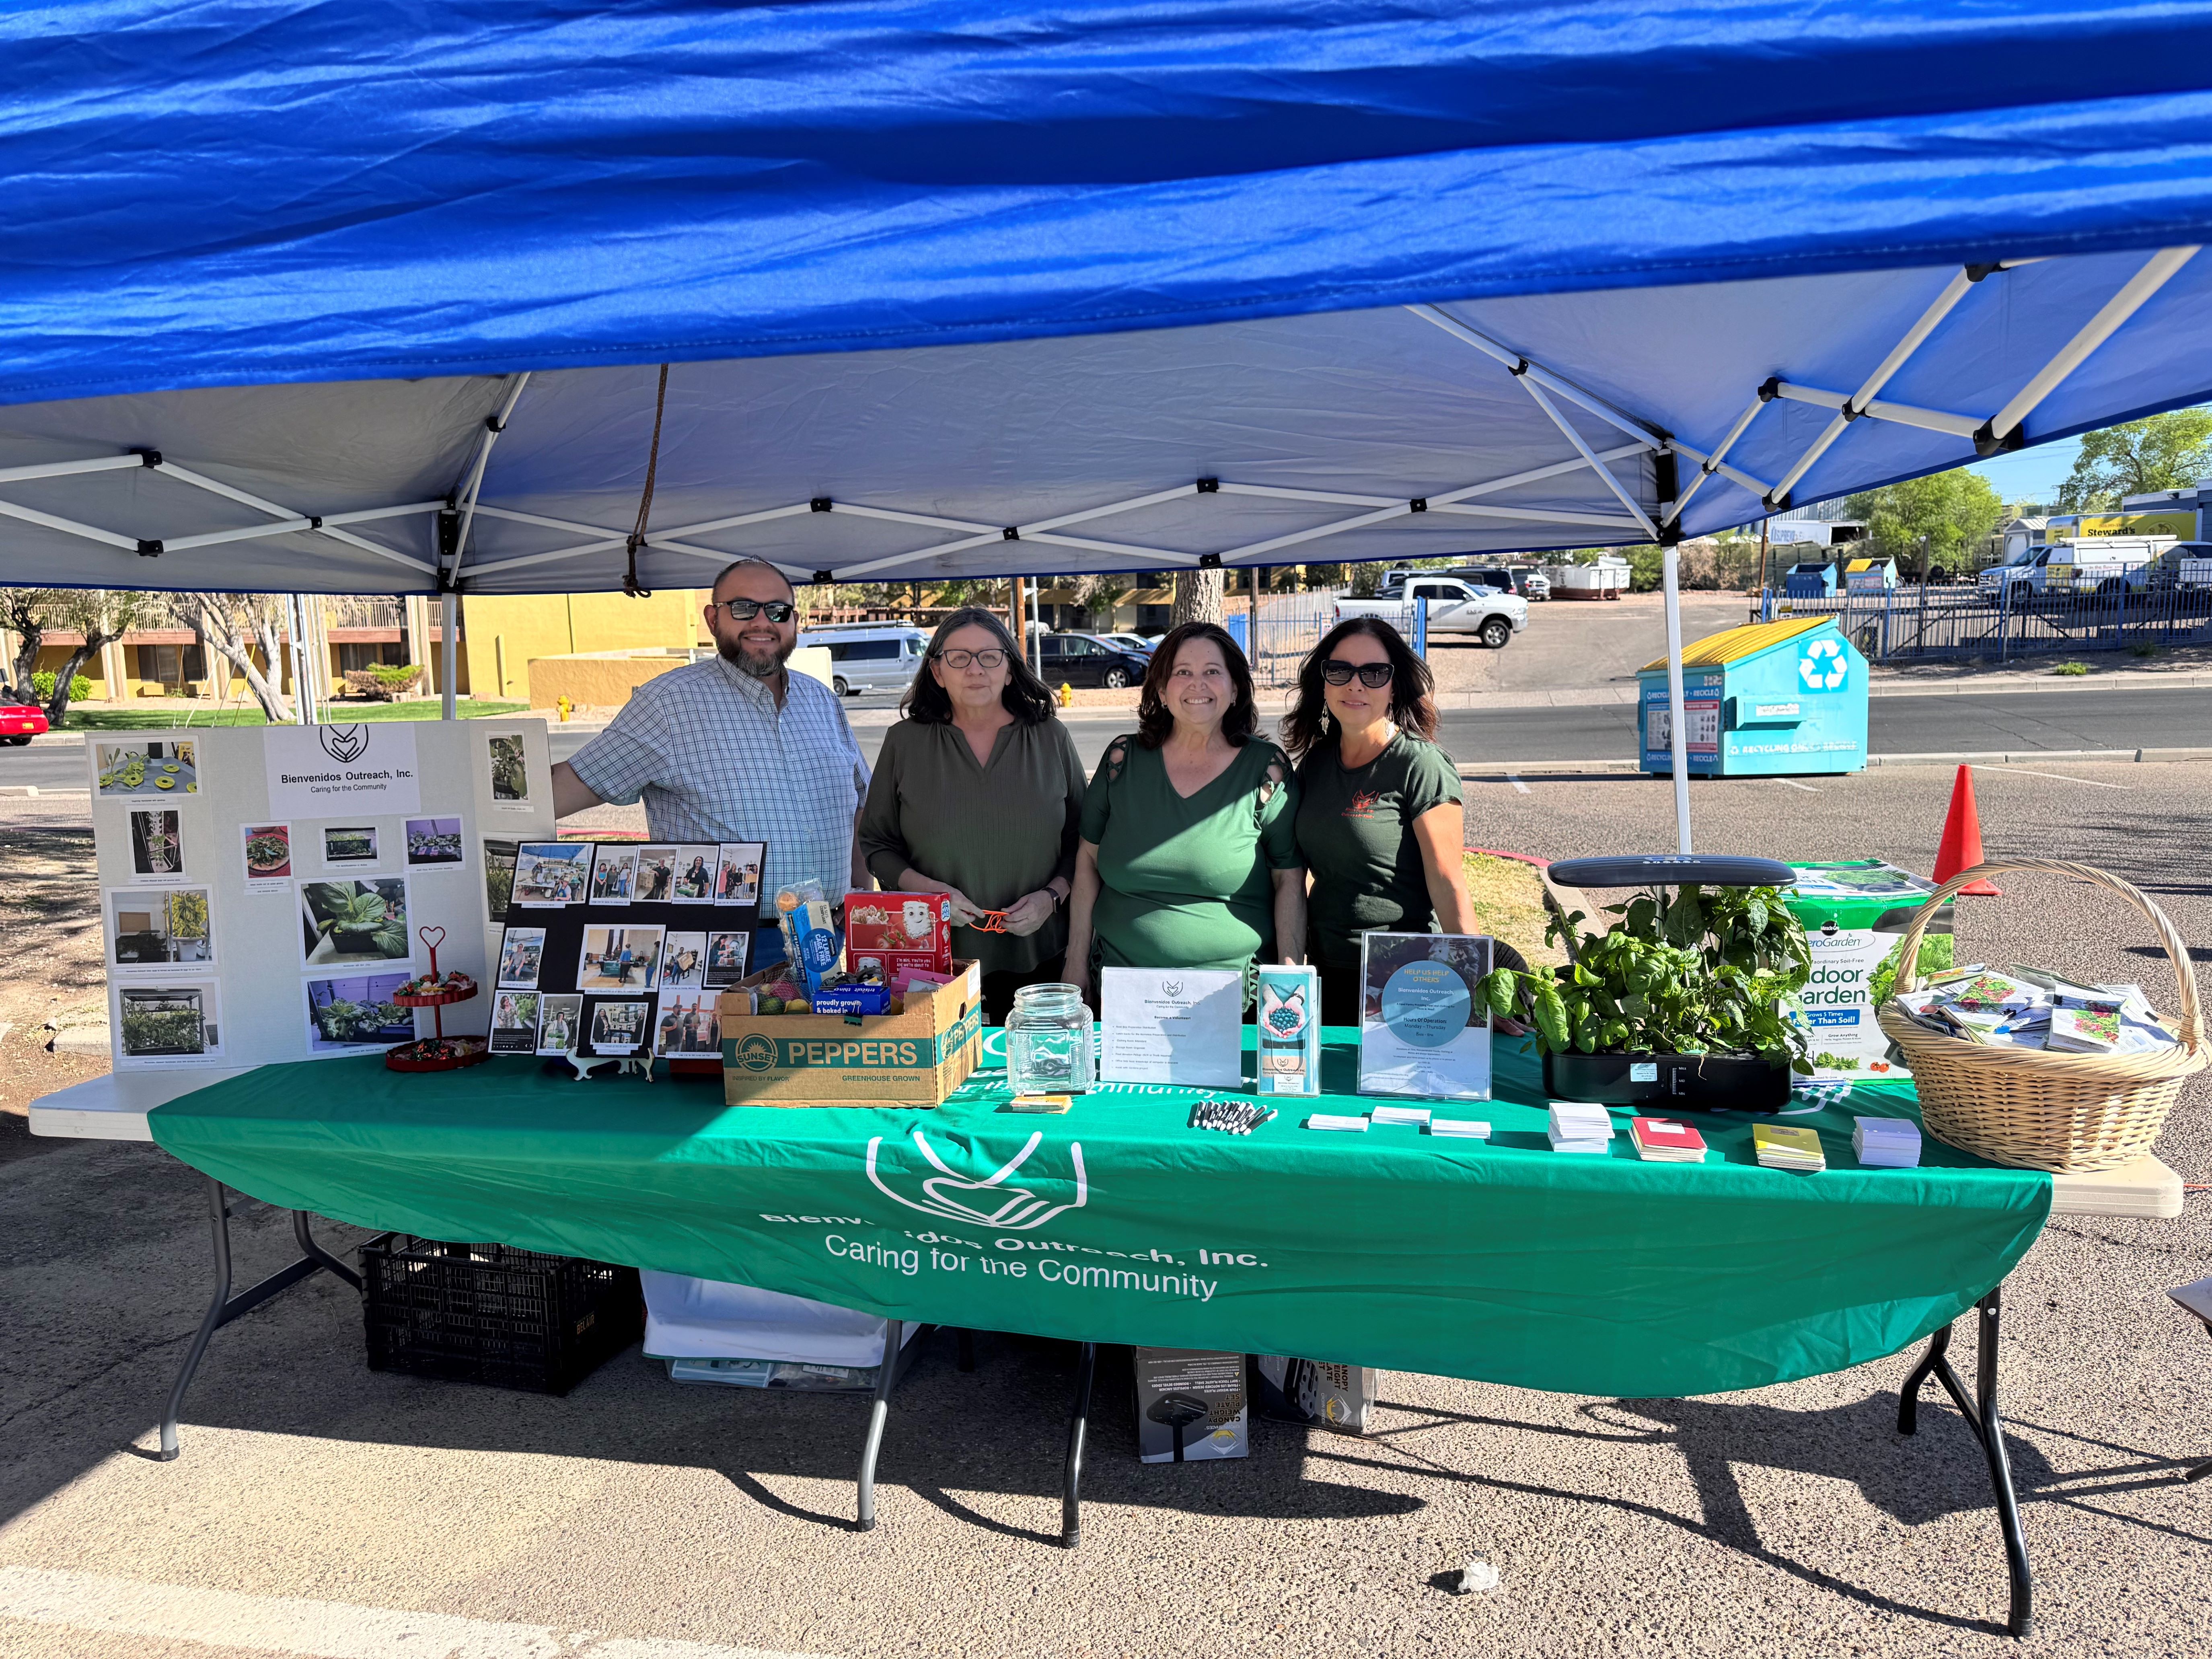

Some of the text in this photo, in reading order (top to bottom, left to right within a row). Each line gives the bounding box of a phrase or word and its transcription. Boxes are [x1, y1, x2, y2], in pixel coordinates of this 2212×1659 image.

[2088, 527, 2135, 536] Steward's
[281, 769, 413, 783] Bienvenidos Outreach, Inc.
[353, 783, 387, 791] Community
[1808, 935, 1860, 948] eroGarden
[823, 943, 831, 963] LARGE
[1806, 965, 1864, 984] door
[1798, 985, 1866, 1005] arden
[954, 1010, 979, 1044] PEPPERS
[737, 1053, 777, 1064] SUNSET
[788, 1042, 917, 1065] PEPPERS
[995, 1238, 1268, 1267] Outreach, Inc.
[825, 1234, 1217, 1302] Caring for the Community
[586, 1314, 594, 1328] AIR
